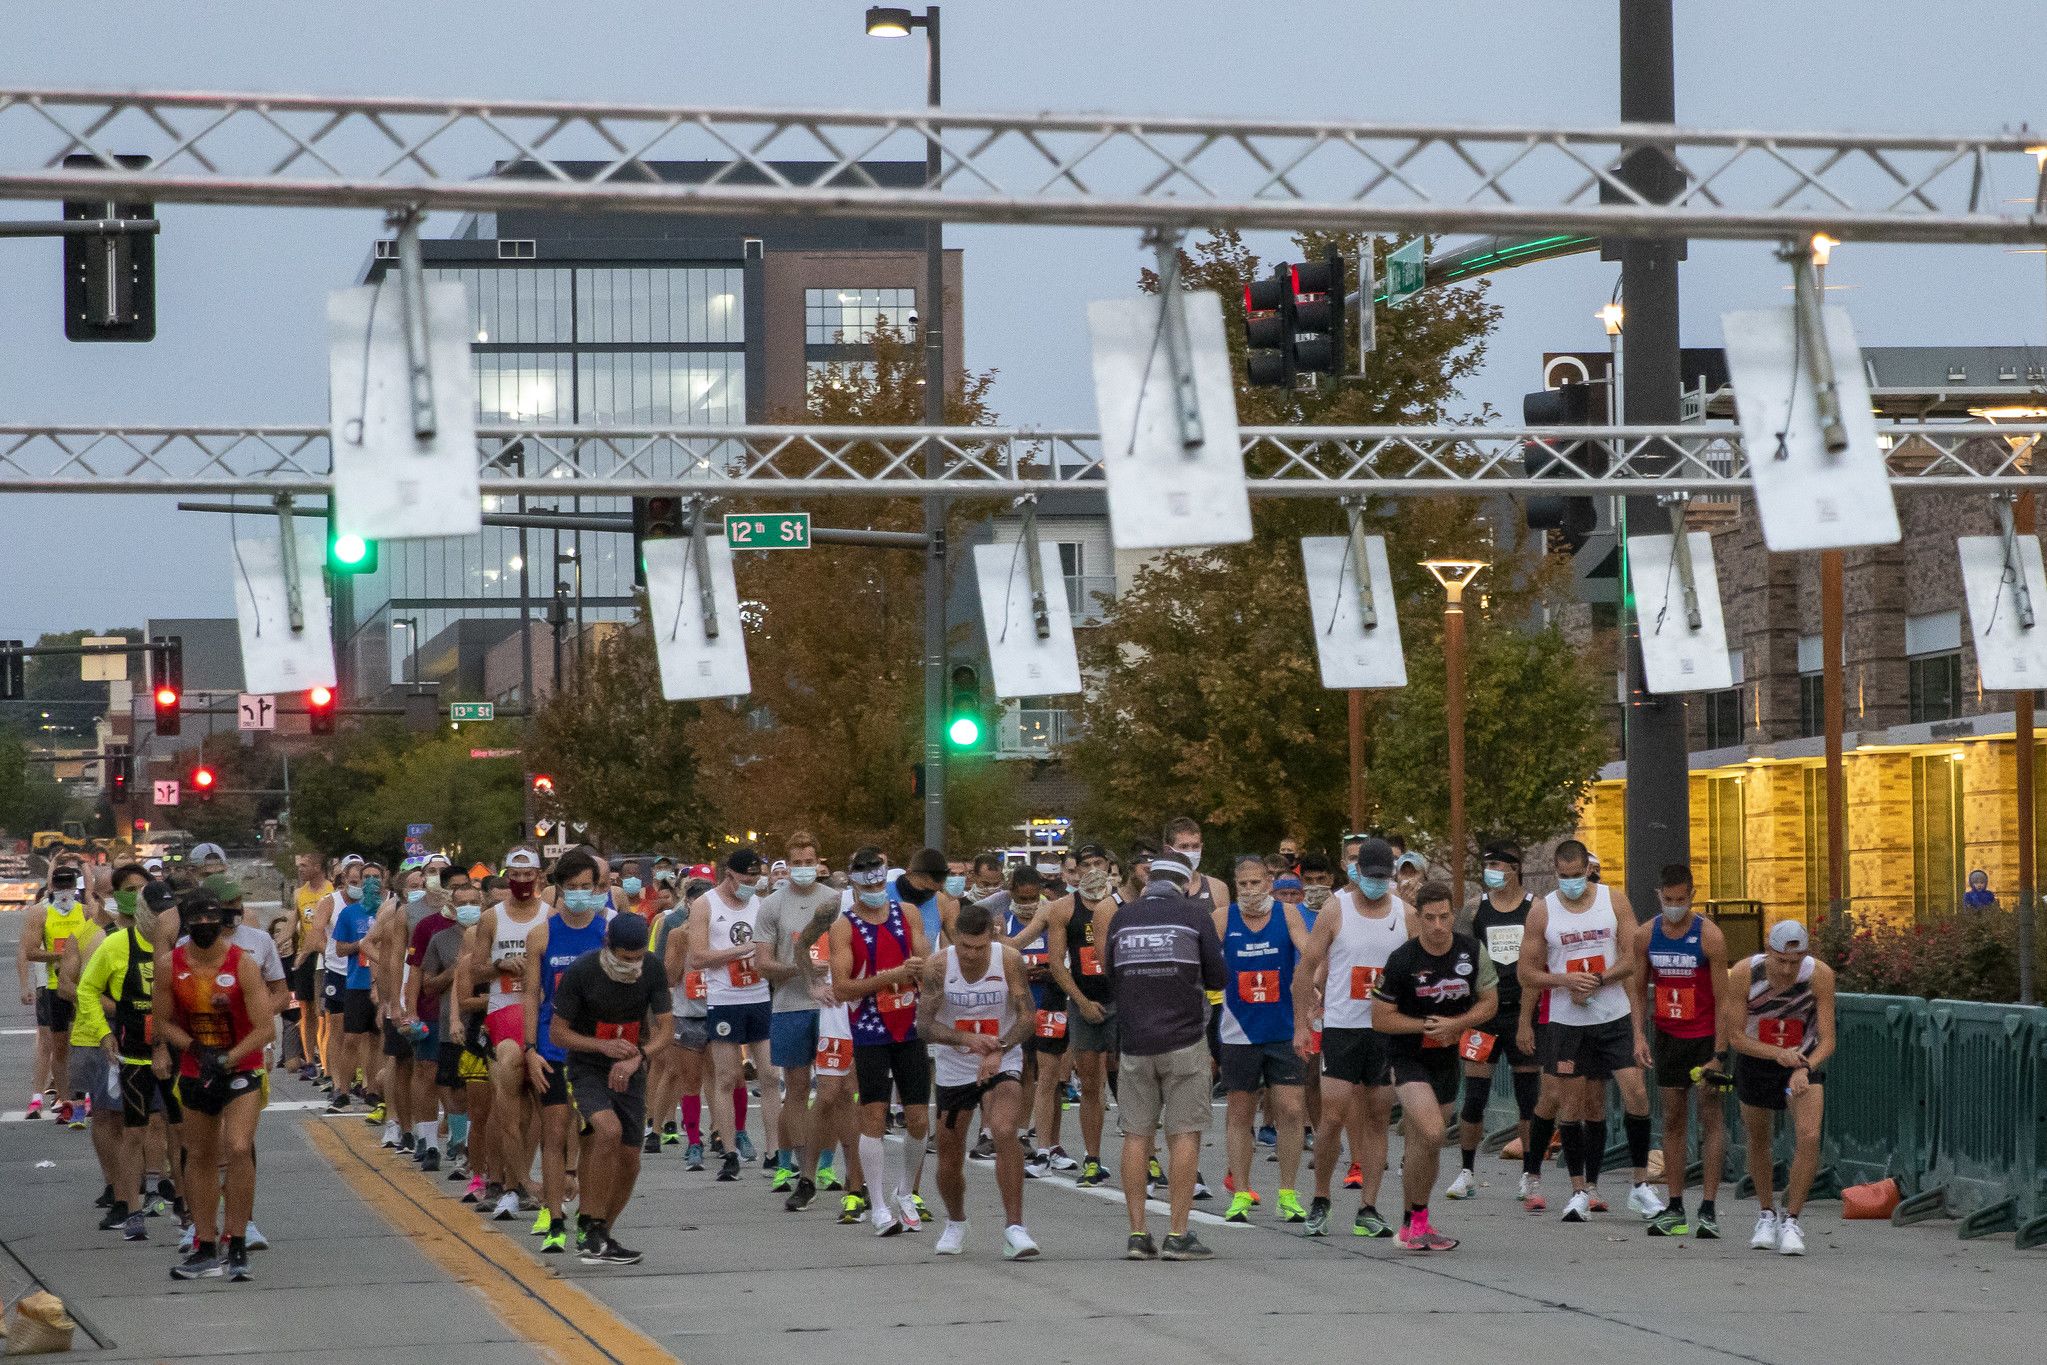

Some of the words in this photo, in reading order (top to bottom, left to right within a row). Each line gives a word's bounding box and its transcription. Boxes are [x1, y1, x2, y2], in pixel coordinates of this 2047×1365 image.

[731, 521, 765, 542] 12th
[780, 521, 803, 541] St
[478, 706, 490, 717] St
[498, 939, 526, 949] NATIO
[1118, 934, 1164, 949] HITS
[1491, 945, 1521, 953] GUARD
[1253, 991, 1266, 1002] 20
[1670, 1007, 1682, 1019] 12
[1776, 1037, 1784, 1046] 3
